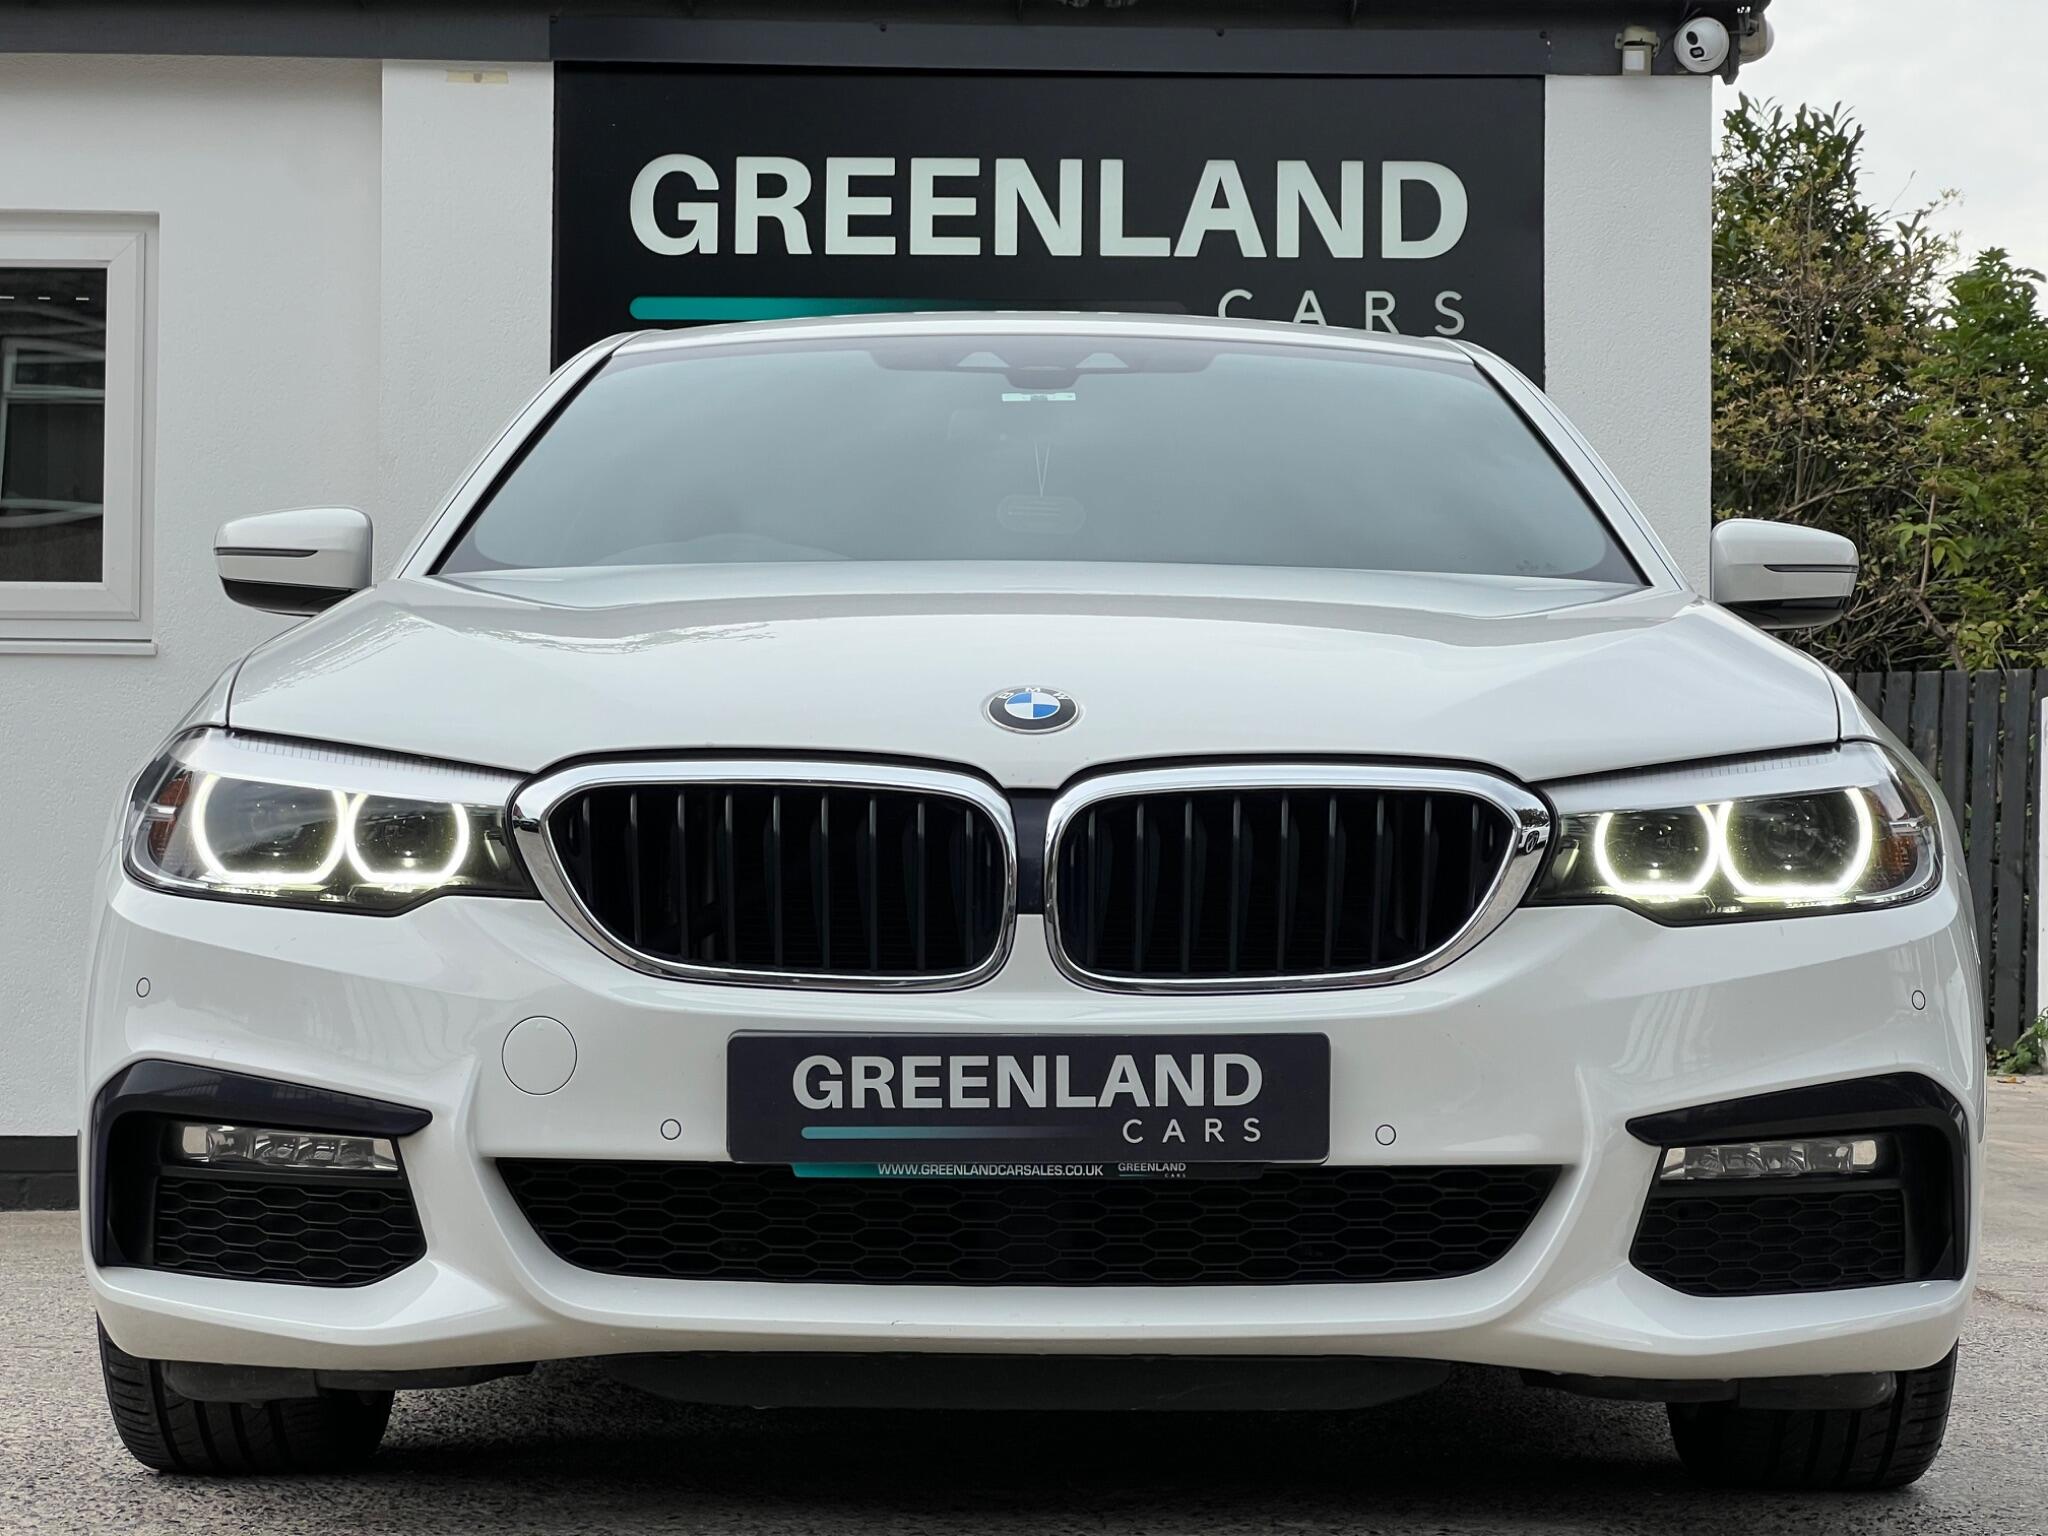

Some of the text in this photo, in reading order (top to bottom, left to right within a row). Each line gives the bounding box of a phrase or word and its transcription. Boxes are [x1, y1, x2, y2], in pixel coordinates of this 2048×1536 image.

[629, 153, 1468, 259] GREENLAND
[1218, 288, 1466, 336] CARS
[997, 687, 1070, 700] BMW
[792, 1053, 1263, 1110] GREENLAND
[1122, 1118, 1262, 1144] CARS
[878, 1163, 1104, 1176] WWW.GREENLANDCARSALES.CO.UK
[1118, 1162, 1186, 1171] GREENLAND
